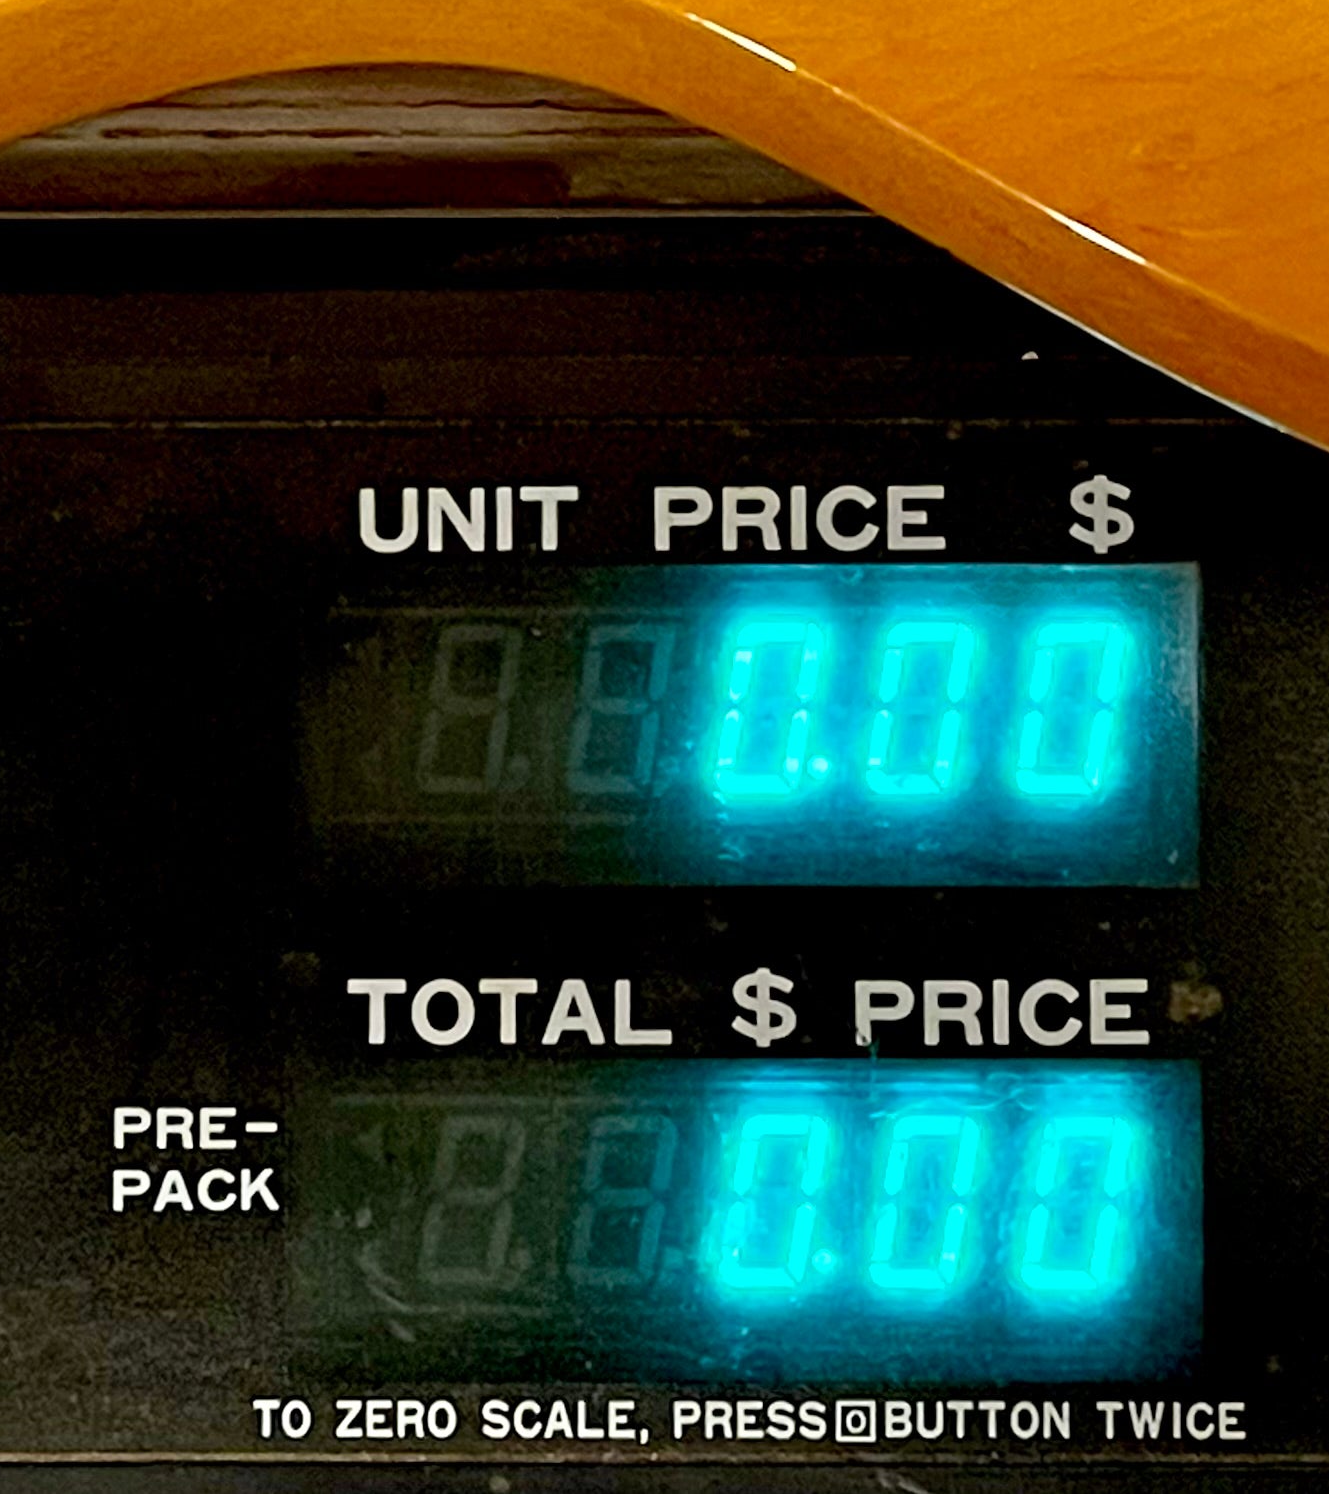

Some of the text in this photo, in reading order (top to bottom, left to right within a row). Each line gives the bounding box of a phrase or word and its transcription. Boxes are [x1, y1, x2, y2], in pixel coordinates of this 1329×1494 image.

[359, 474, 1134, 554] UNIT PRICE $
[712, 618, 1125, 798] 0.00
[347, 967, 1150, 1047] TOTAL $ PRICE
[113, 1106, 278, 1150] PRE-
[112, 1168, 280, 1212] PACK
[718, 1113, 1131, 1294] 0.00
[253, 1399, 312, 1439] TO
[335, 1399, 457, 1439] ZERO
[481, 1399, 649, 1445] SCALE,
[673, 1400, 827, 1440] PRESS
[884, 1400, 1070, 1440] BUTTON
[1096, 1400, 1246, 1440] TWICE
